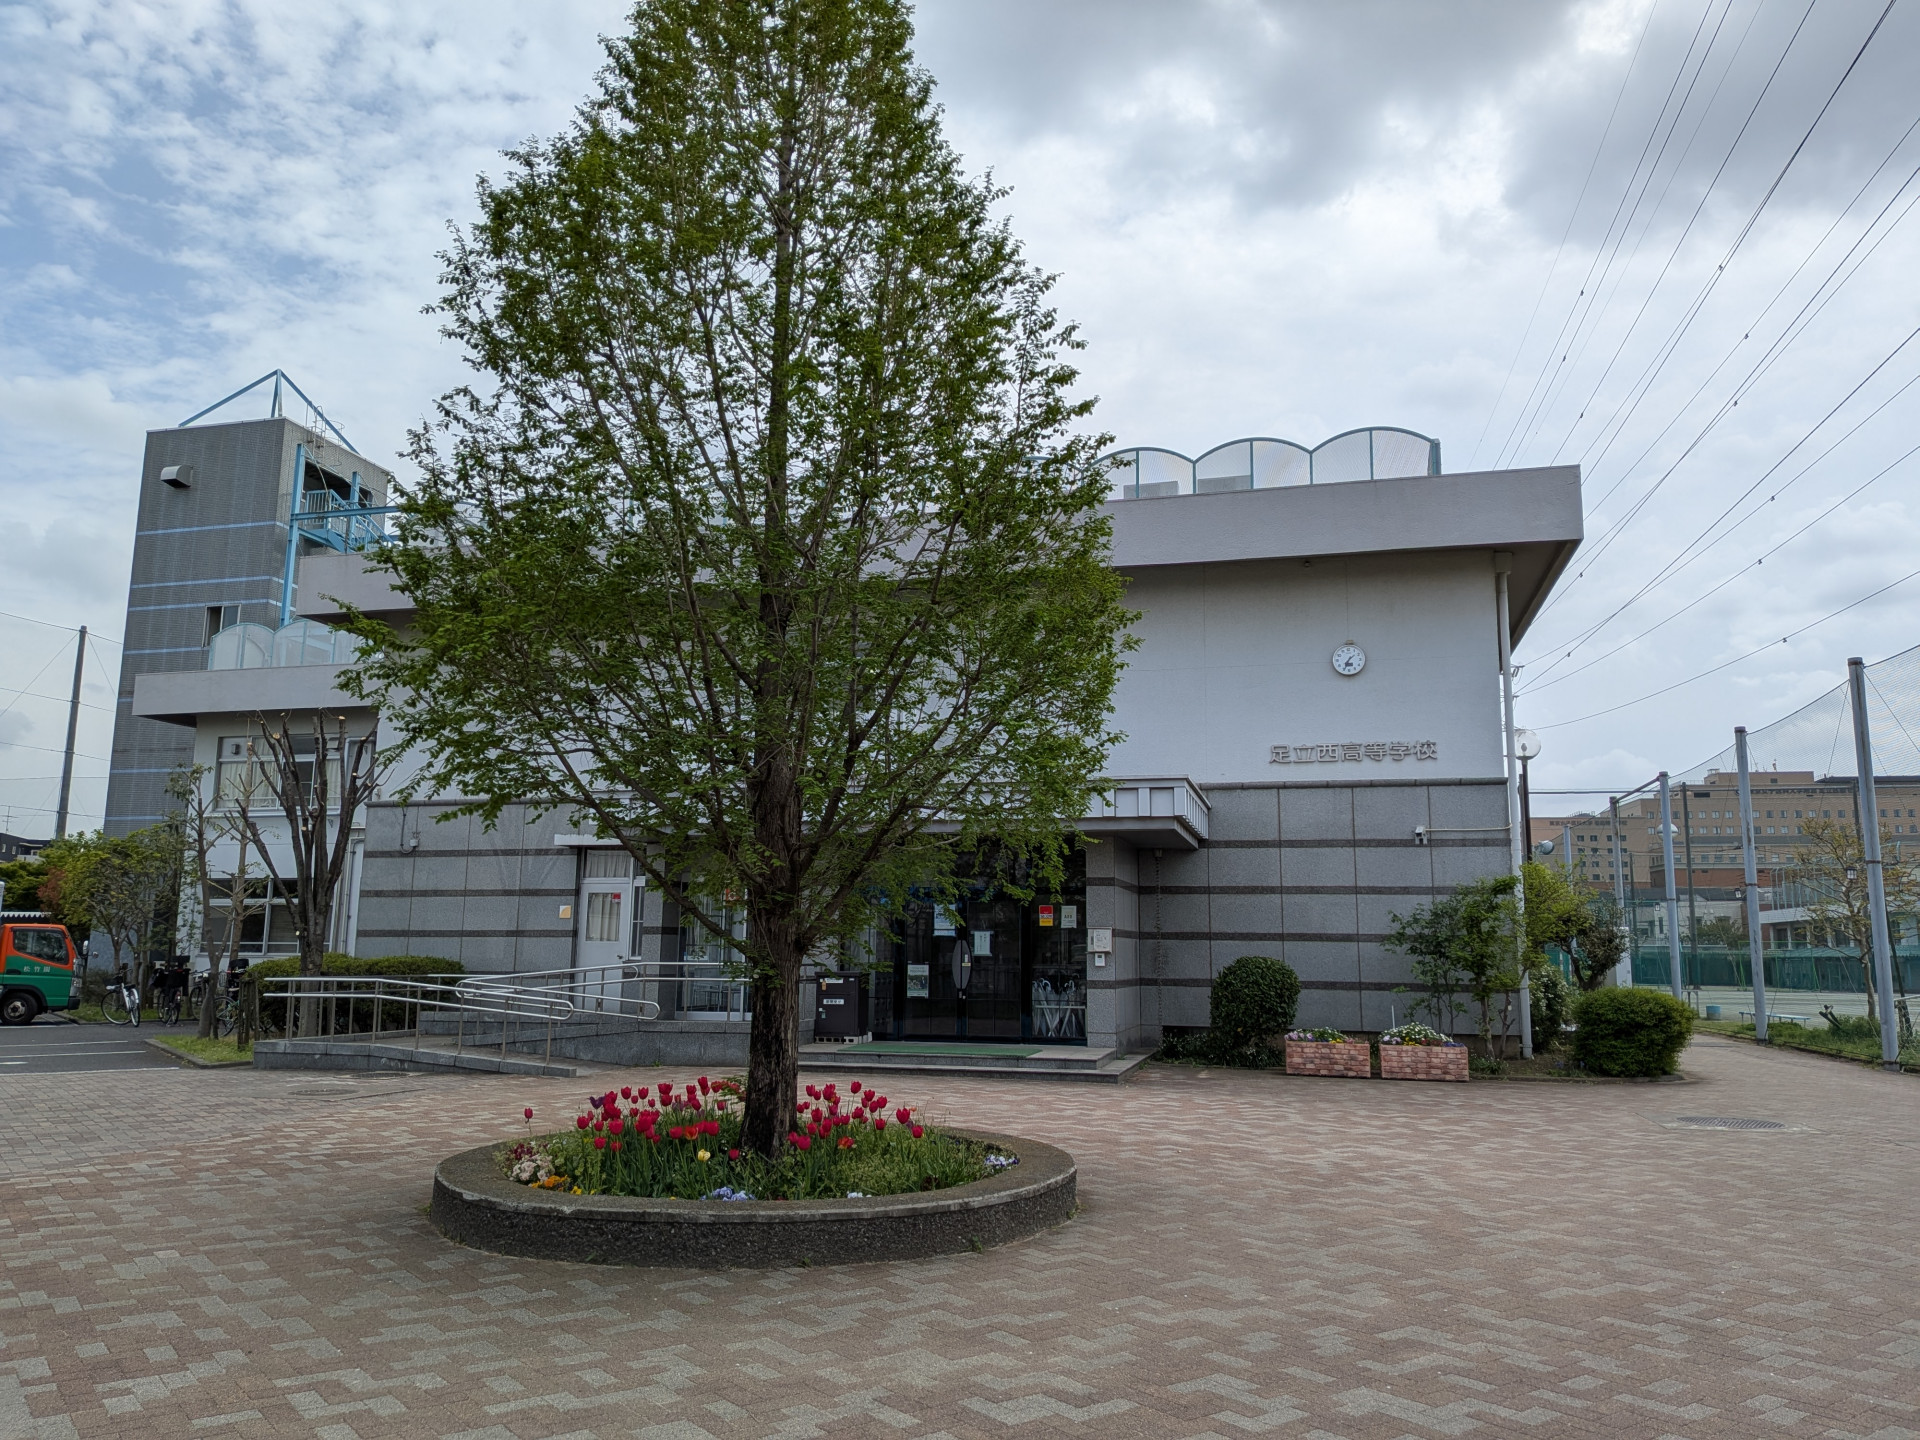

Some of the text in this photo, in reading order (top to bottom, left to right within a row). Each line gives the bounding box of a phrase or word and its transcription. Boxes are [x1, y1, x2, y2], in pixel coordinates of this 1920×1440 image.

[1269, 740, 1438, 764] 足立西高等学校
